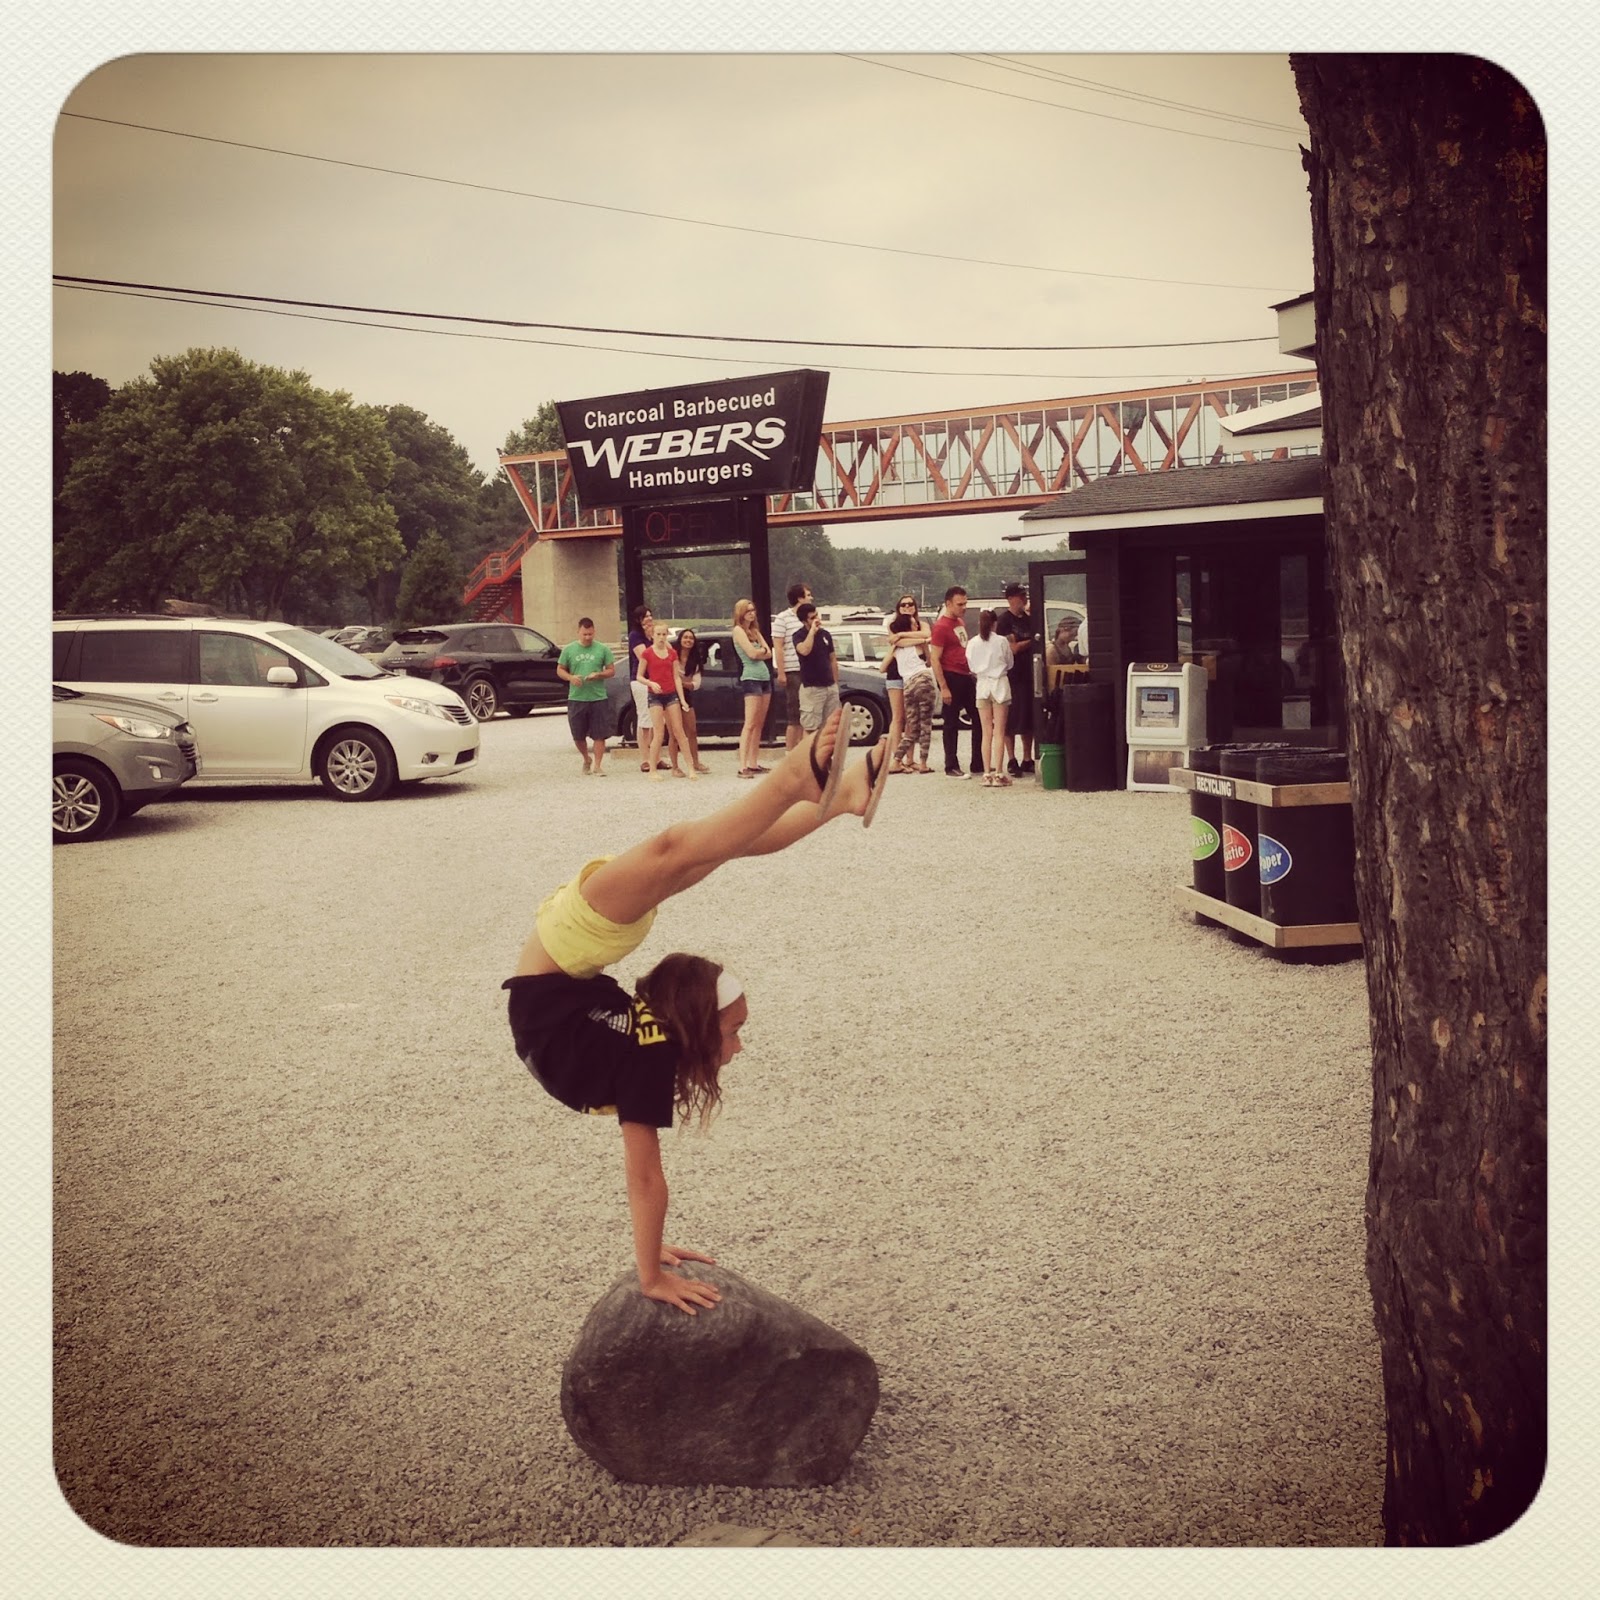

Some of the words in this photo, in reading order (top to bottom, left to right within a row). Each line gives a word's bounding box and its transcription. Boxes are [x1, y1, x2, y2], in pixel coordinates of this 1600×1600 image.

[584, 403, 664, 429] Charcoal
[674, 387, 775, 419] Barbecued
[567, 417, 786, 479] WEBERS
[629, 462, 753, 489] Hamburgers
[1196, 776, 1231, 797] RECYCLING
[1192, 832, 1215, 848] aste
